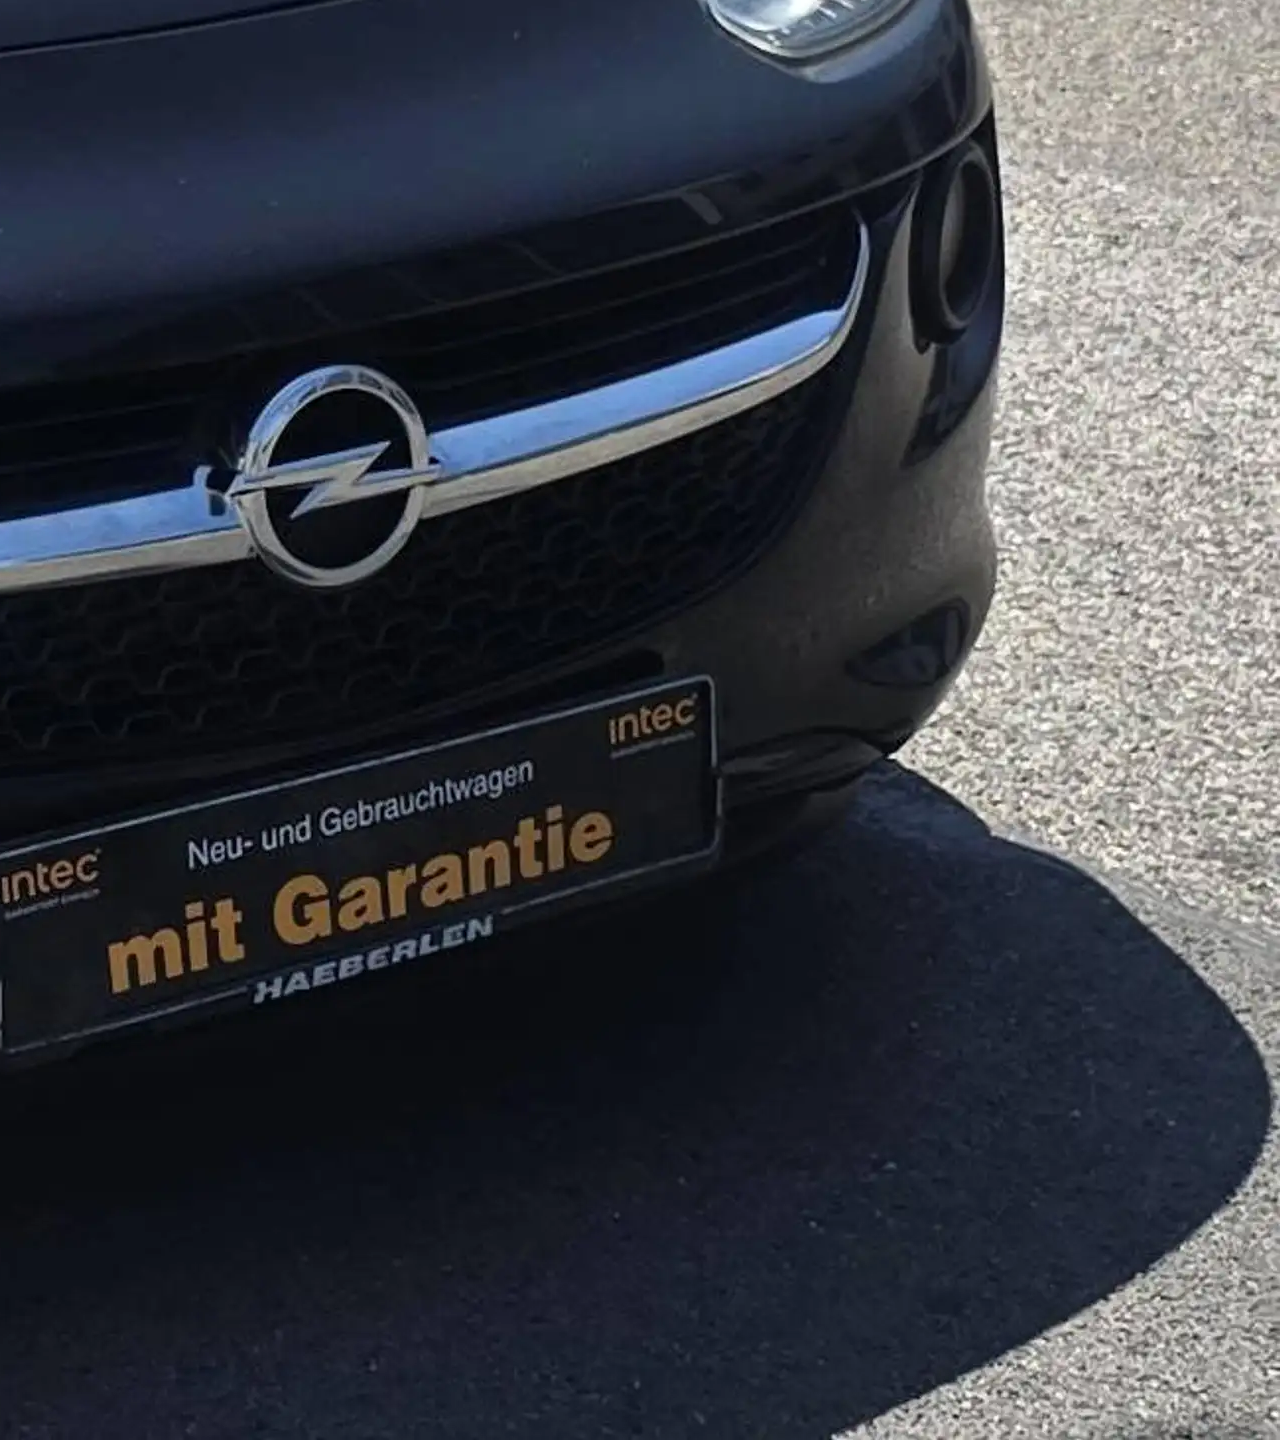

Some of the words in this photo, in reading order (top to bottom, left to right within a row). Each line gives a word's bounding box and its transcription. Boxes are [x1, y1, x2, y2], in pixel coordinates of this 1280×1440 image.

[187, 831, 253, 871] Neu-
[261, 811, 312, 852] und
[319, 760, 534, 837] Gebrauchtwagen
[107, 898, 246, 994] mit
[272, 805, 614, 946] Garantie
[252, 915, 495, 1005] HAEBERLEN
